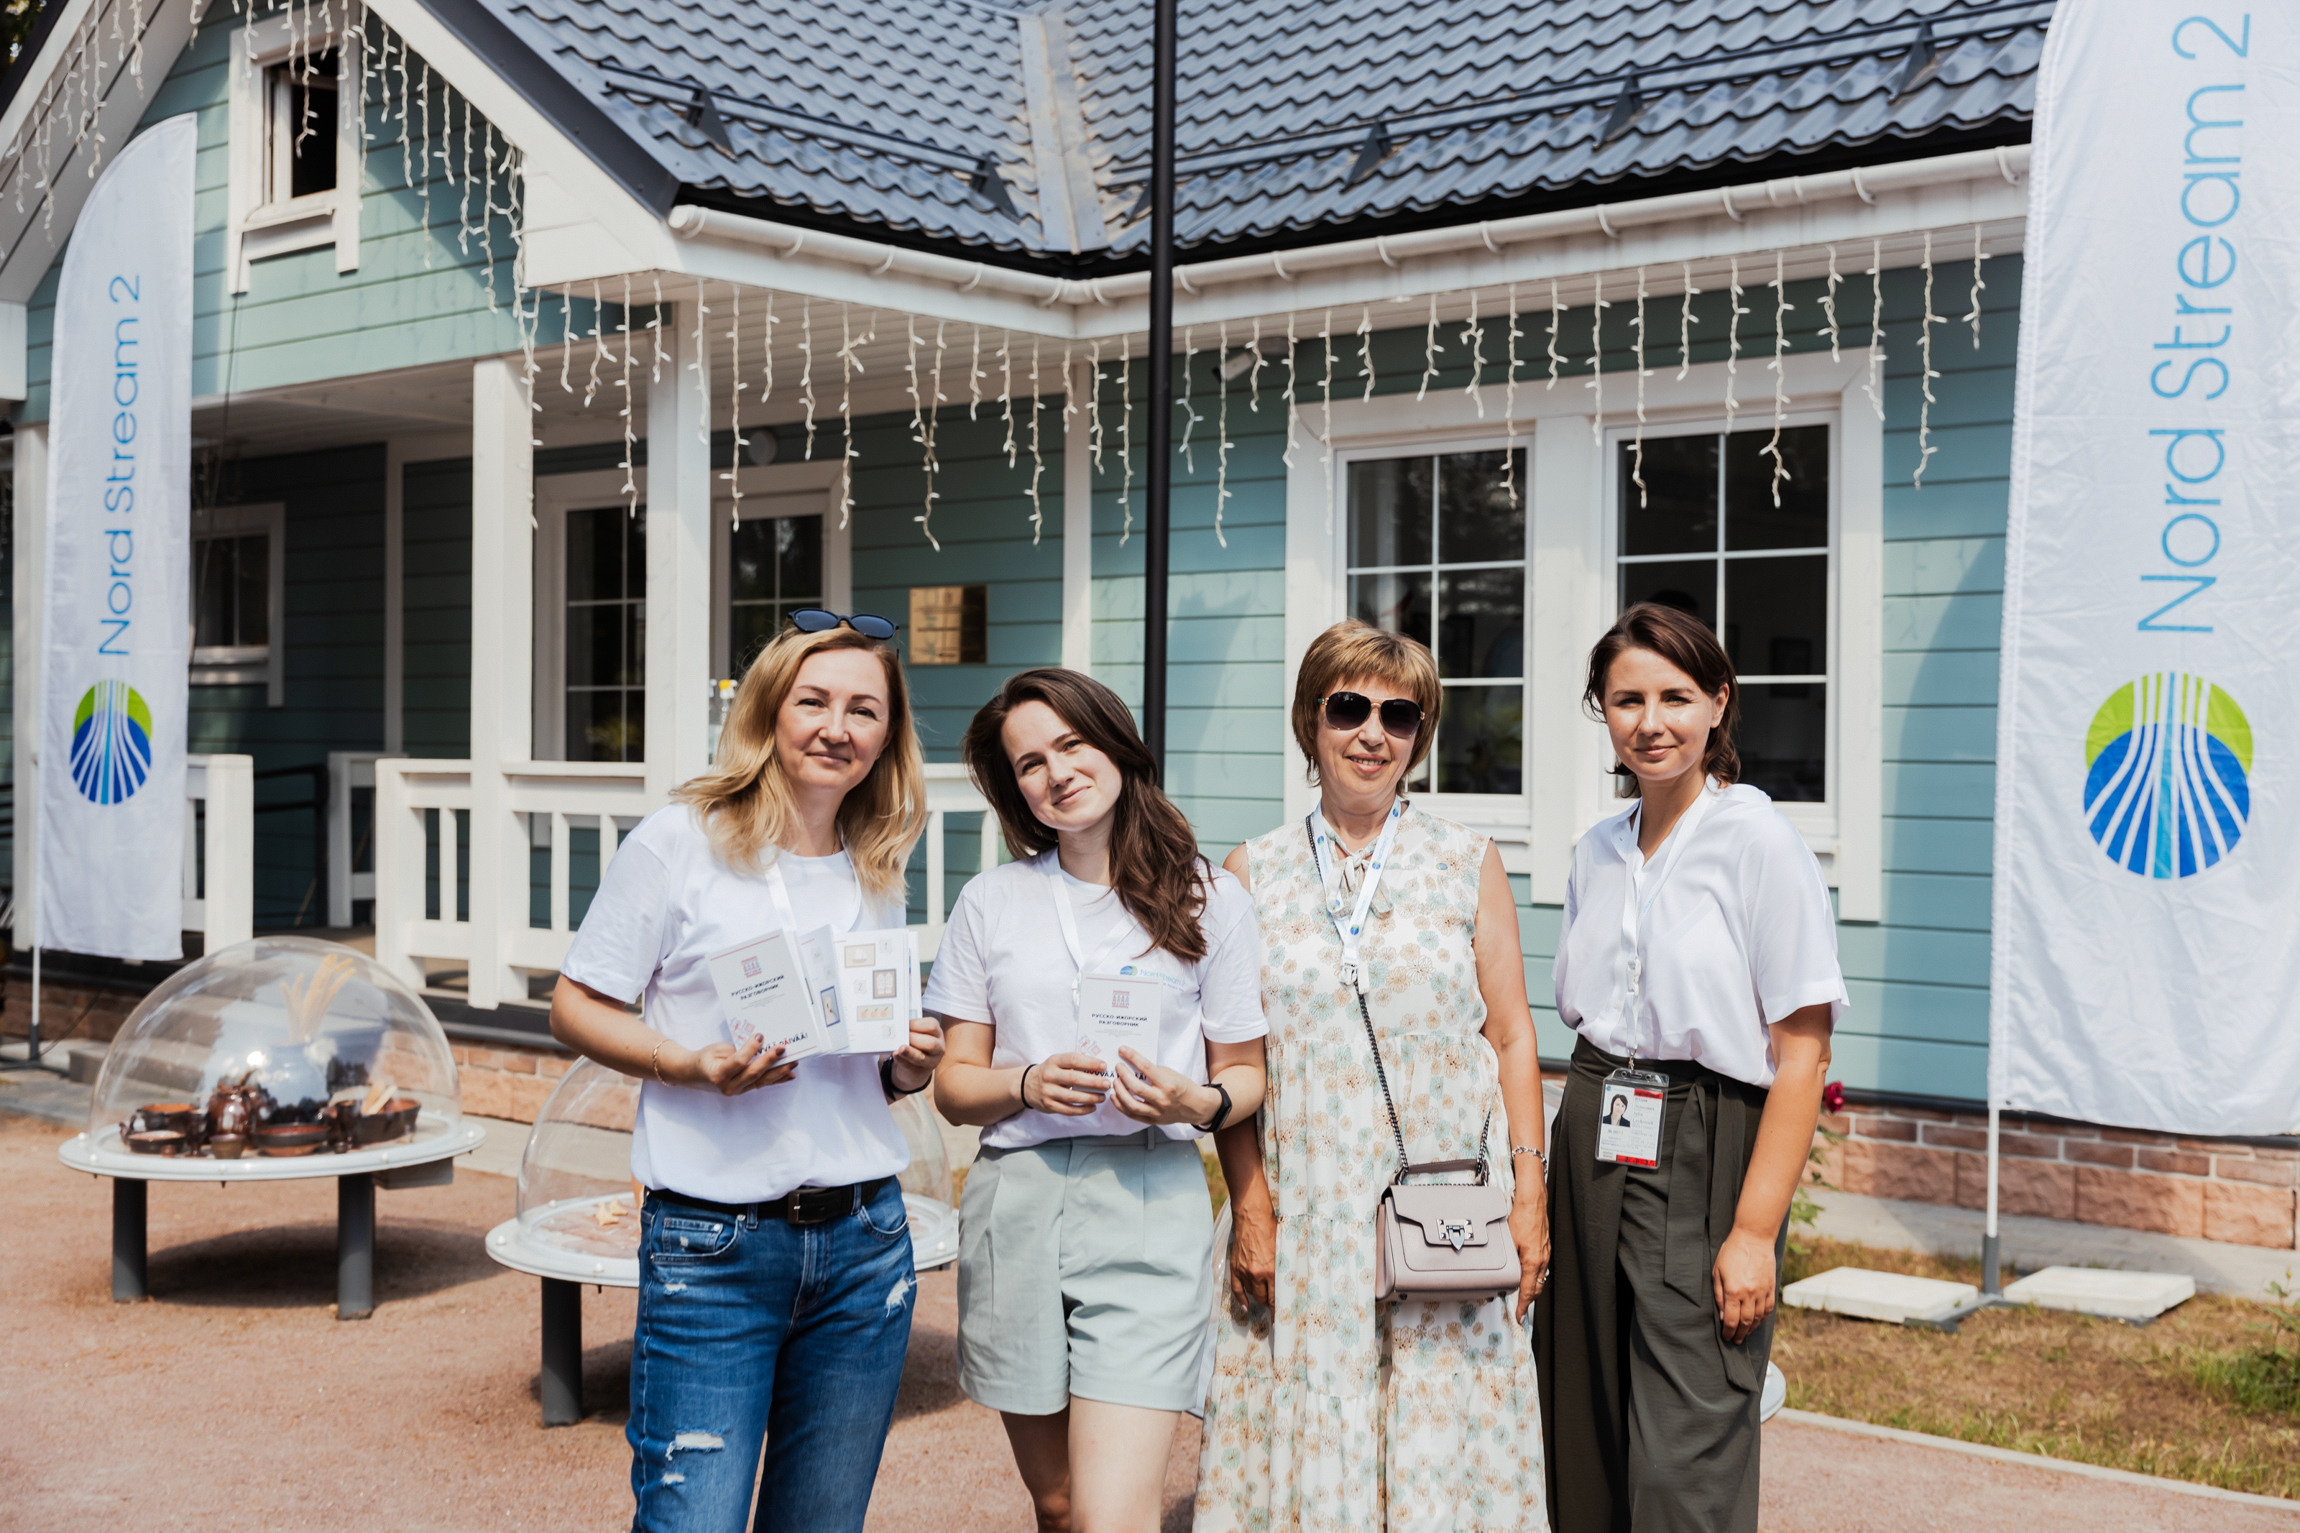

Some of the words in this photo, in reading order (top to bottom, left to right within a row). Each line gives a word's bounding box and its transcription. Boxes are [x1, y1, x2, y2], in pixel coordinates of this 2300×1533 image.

[2172, 13, 2250, 60] 2
[109, 275, 140, 303] 2
[2150, 84, 2246, 401] Stream
[104, 317, 139, 513] Stream
[98, 529, 134, 656] Nord
[2137, 428, 2226, 633] Nord
